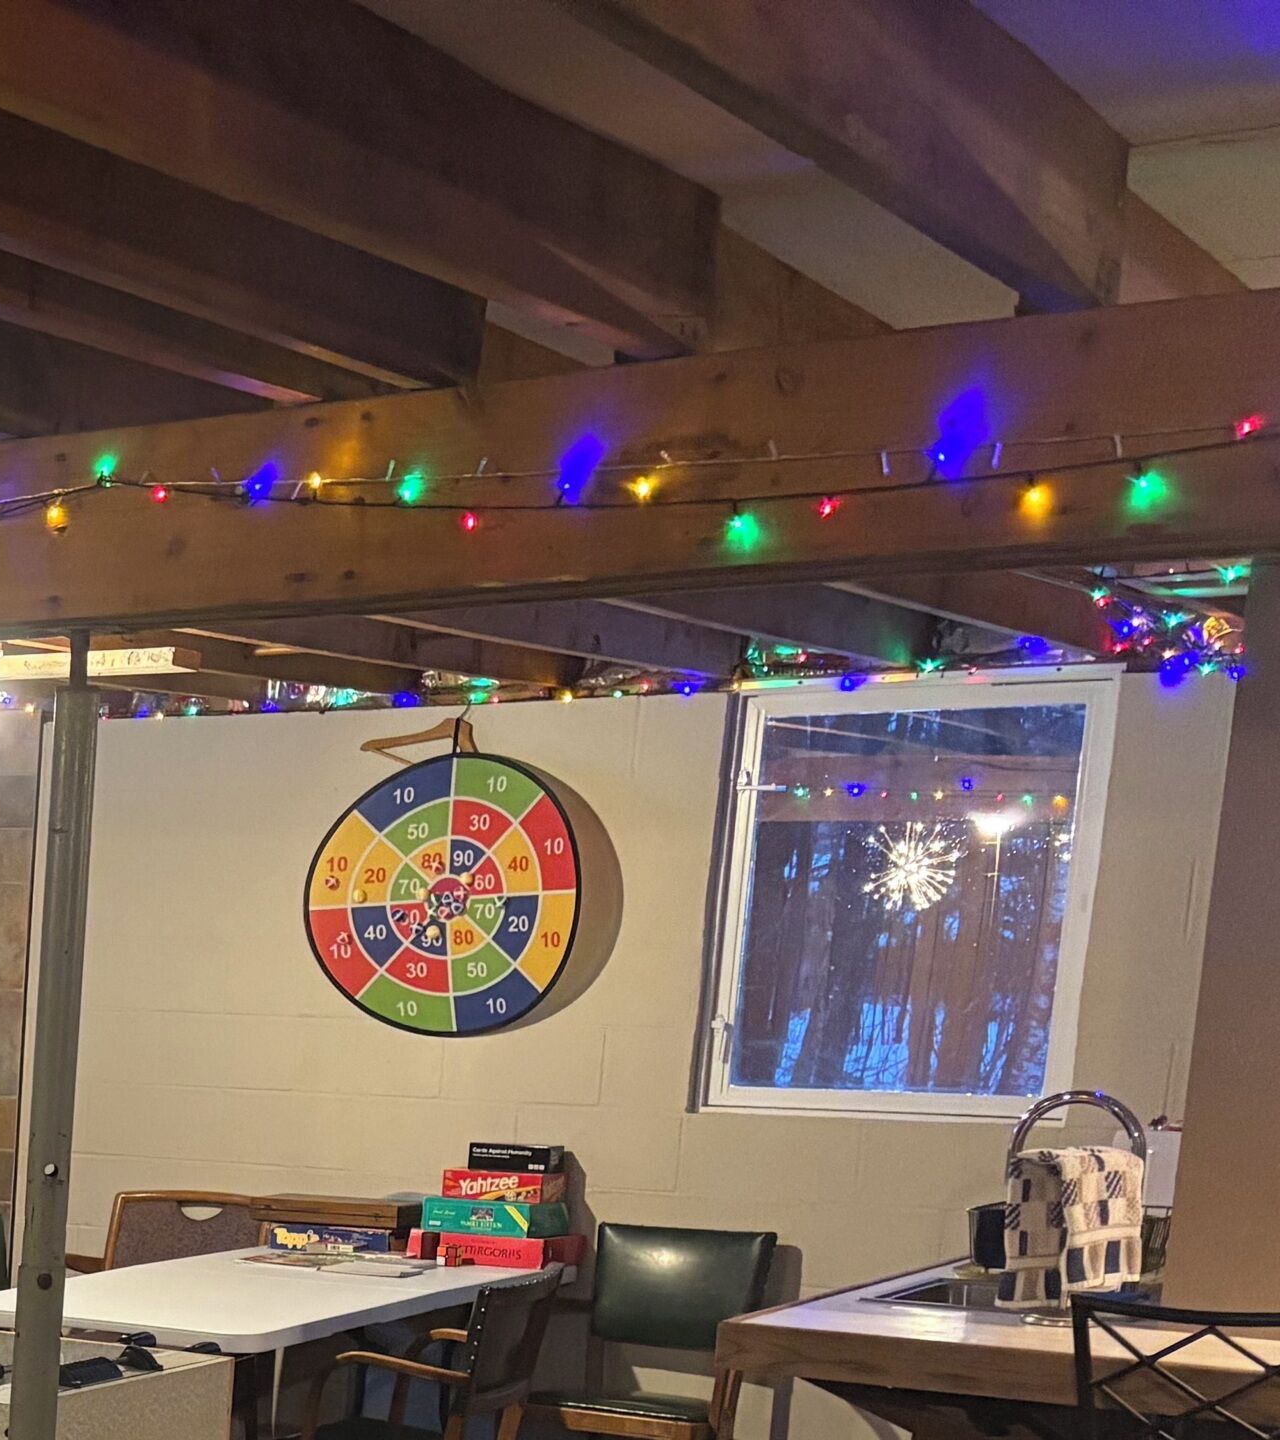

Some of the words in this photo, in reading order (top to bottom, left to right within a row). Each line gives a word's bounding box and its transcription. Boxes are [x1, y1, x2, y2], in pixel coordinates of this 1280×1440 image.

[487, 776, 507, 793] 10
[393, 787, 415, 804] 10
[469, 814, 490, 831] 30
[407, 823, 429, 839] 50
[544, 838, 564, 855] 10
[327, 856, 348, 873] 10
[453, 850, 474, 866] 90
[507, 856, 529, 872] 40
[364, 868, 386, 884] 20
[474, 874, 495, 891] 60
[398, 878, 420, 894] 70
[474, 903, 495, 919] 70
[364, 924, 386, 940] 40
[508, 916, 529, 932] 20
[454, 929, 474, 945] 80
[541, 932, 560, 948] 10
[329, 943, 351, 959] 10
[406, 962, 427, 978] 30
[466, 962, 487, 978] 50
[396, 1001, 417, 1016] 10
[486, 998, 506, 1014] 10
[459, 1175, 519, 1195] Yahtzee
